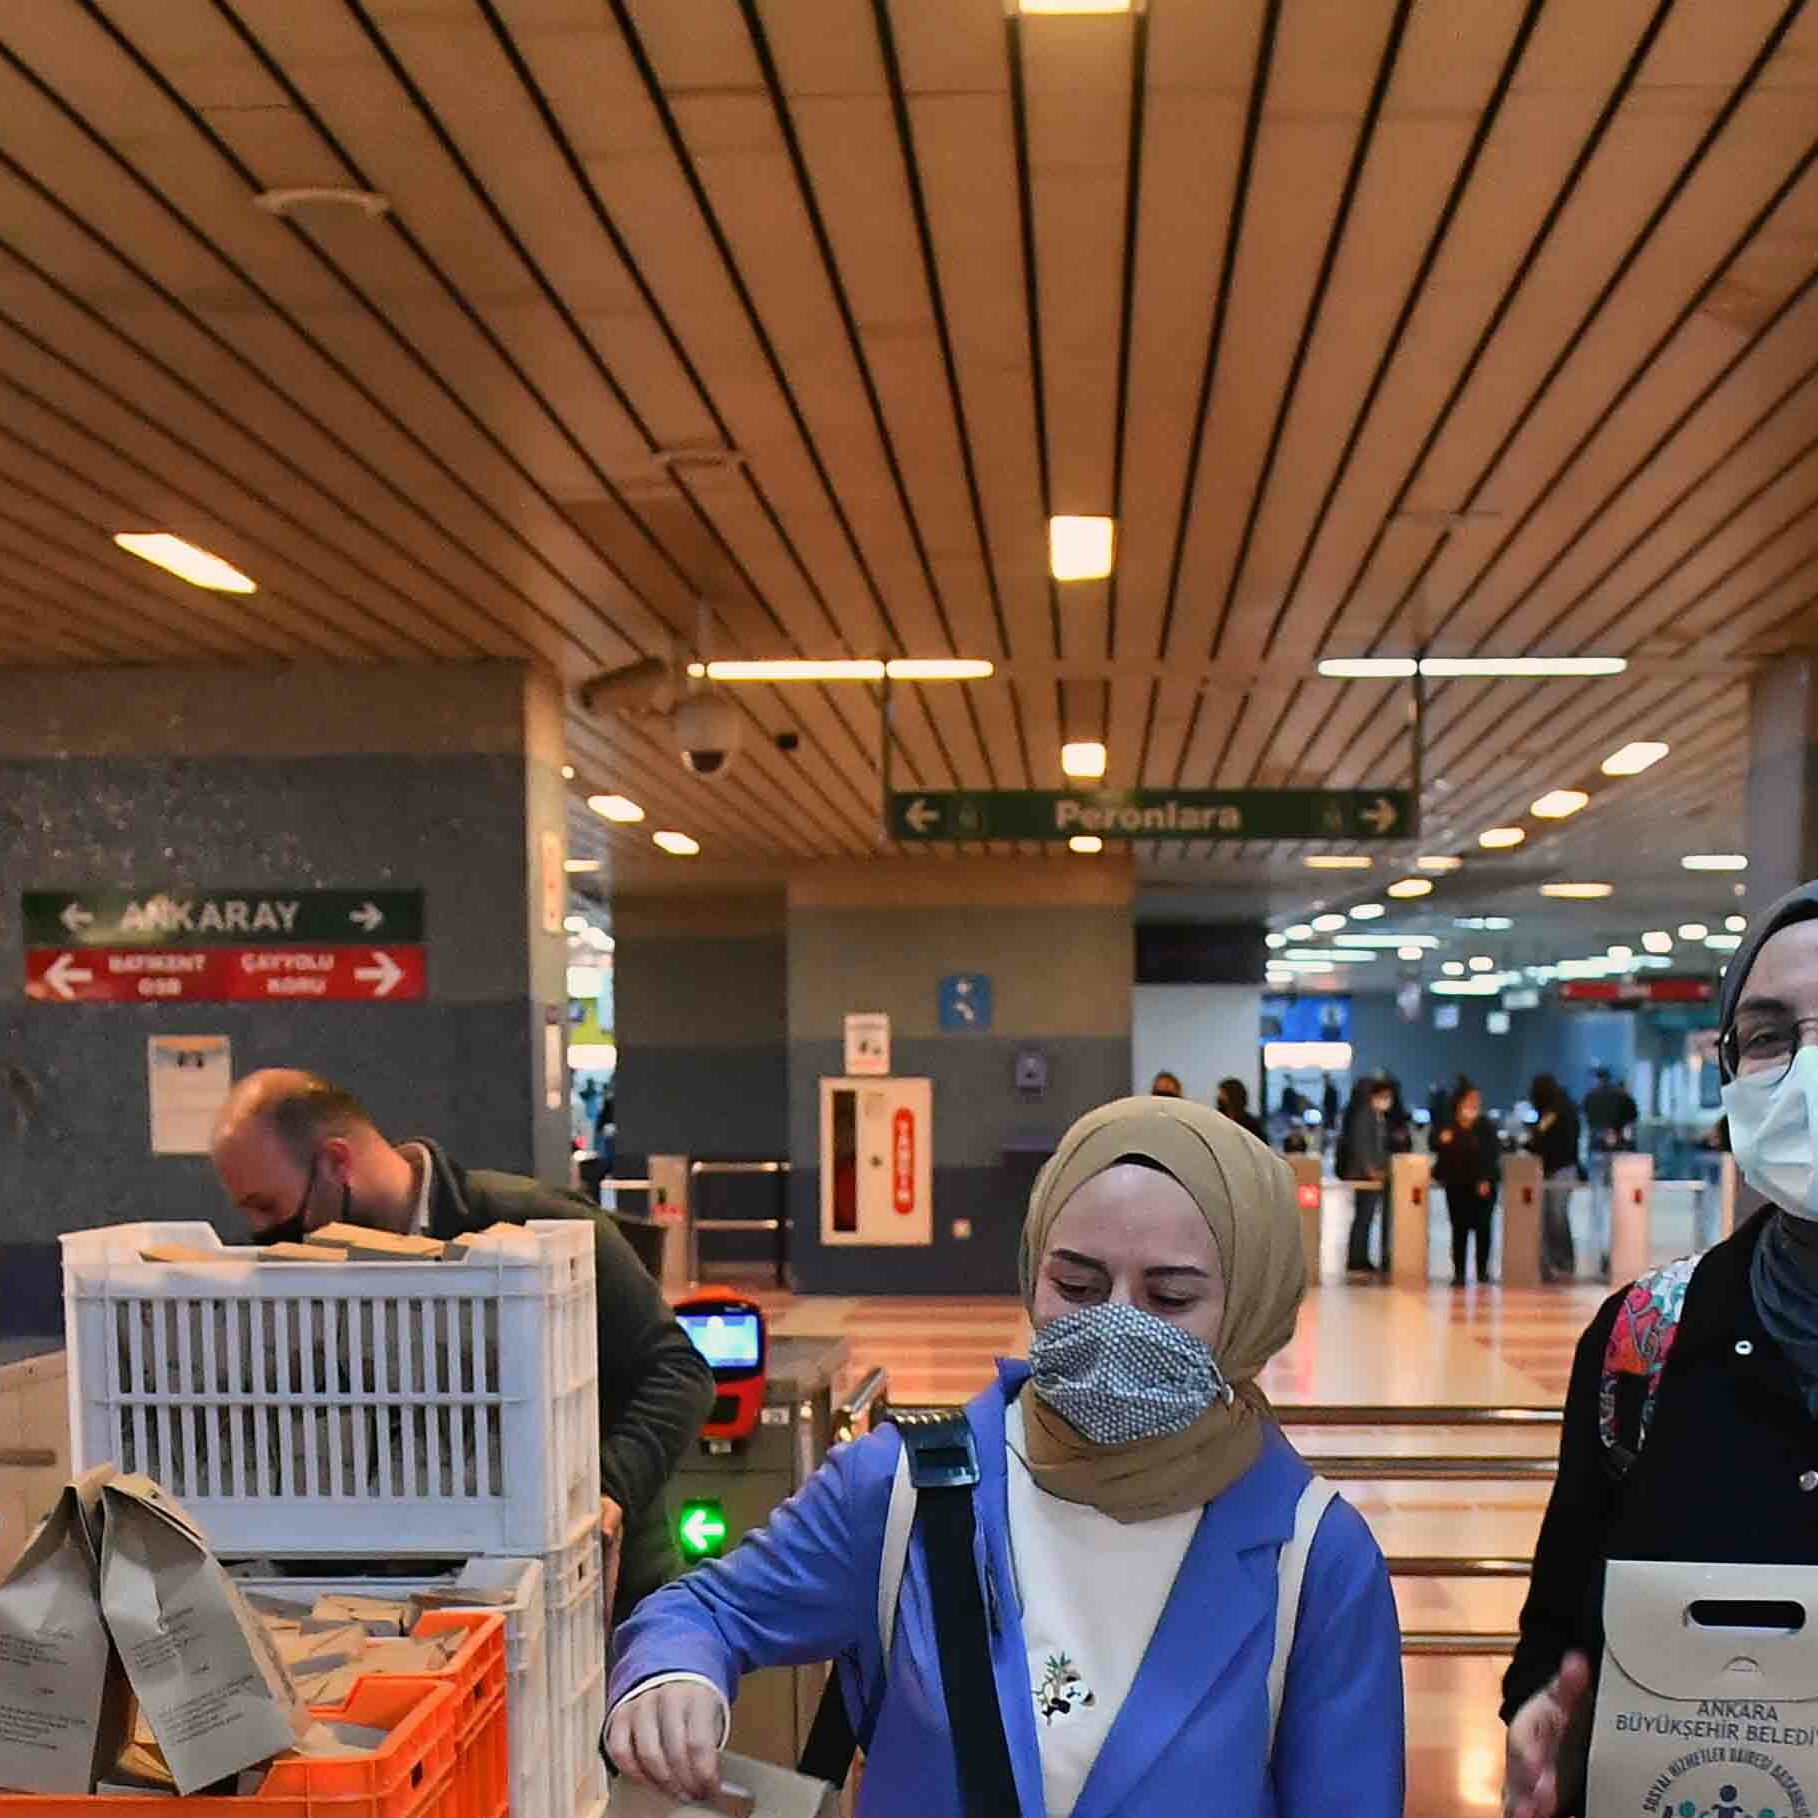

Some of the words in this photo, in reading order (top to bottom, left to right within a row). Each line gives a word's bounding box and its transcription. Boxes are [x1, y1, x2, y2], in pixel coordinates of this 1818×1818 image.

[1055, 799, 1240, 831] Peronlara
[119, 899, 299, 932] ANKARAY
[1698, 1701, 1779, 1722] ANKARA
[1616, 1713, 1739, 1741] BÜYÜKŞEHİR
